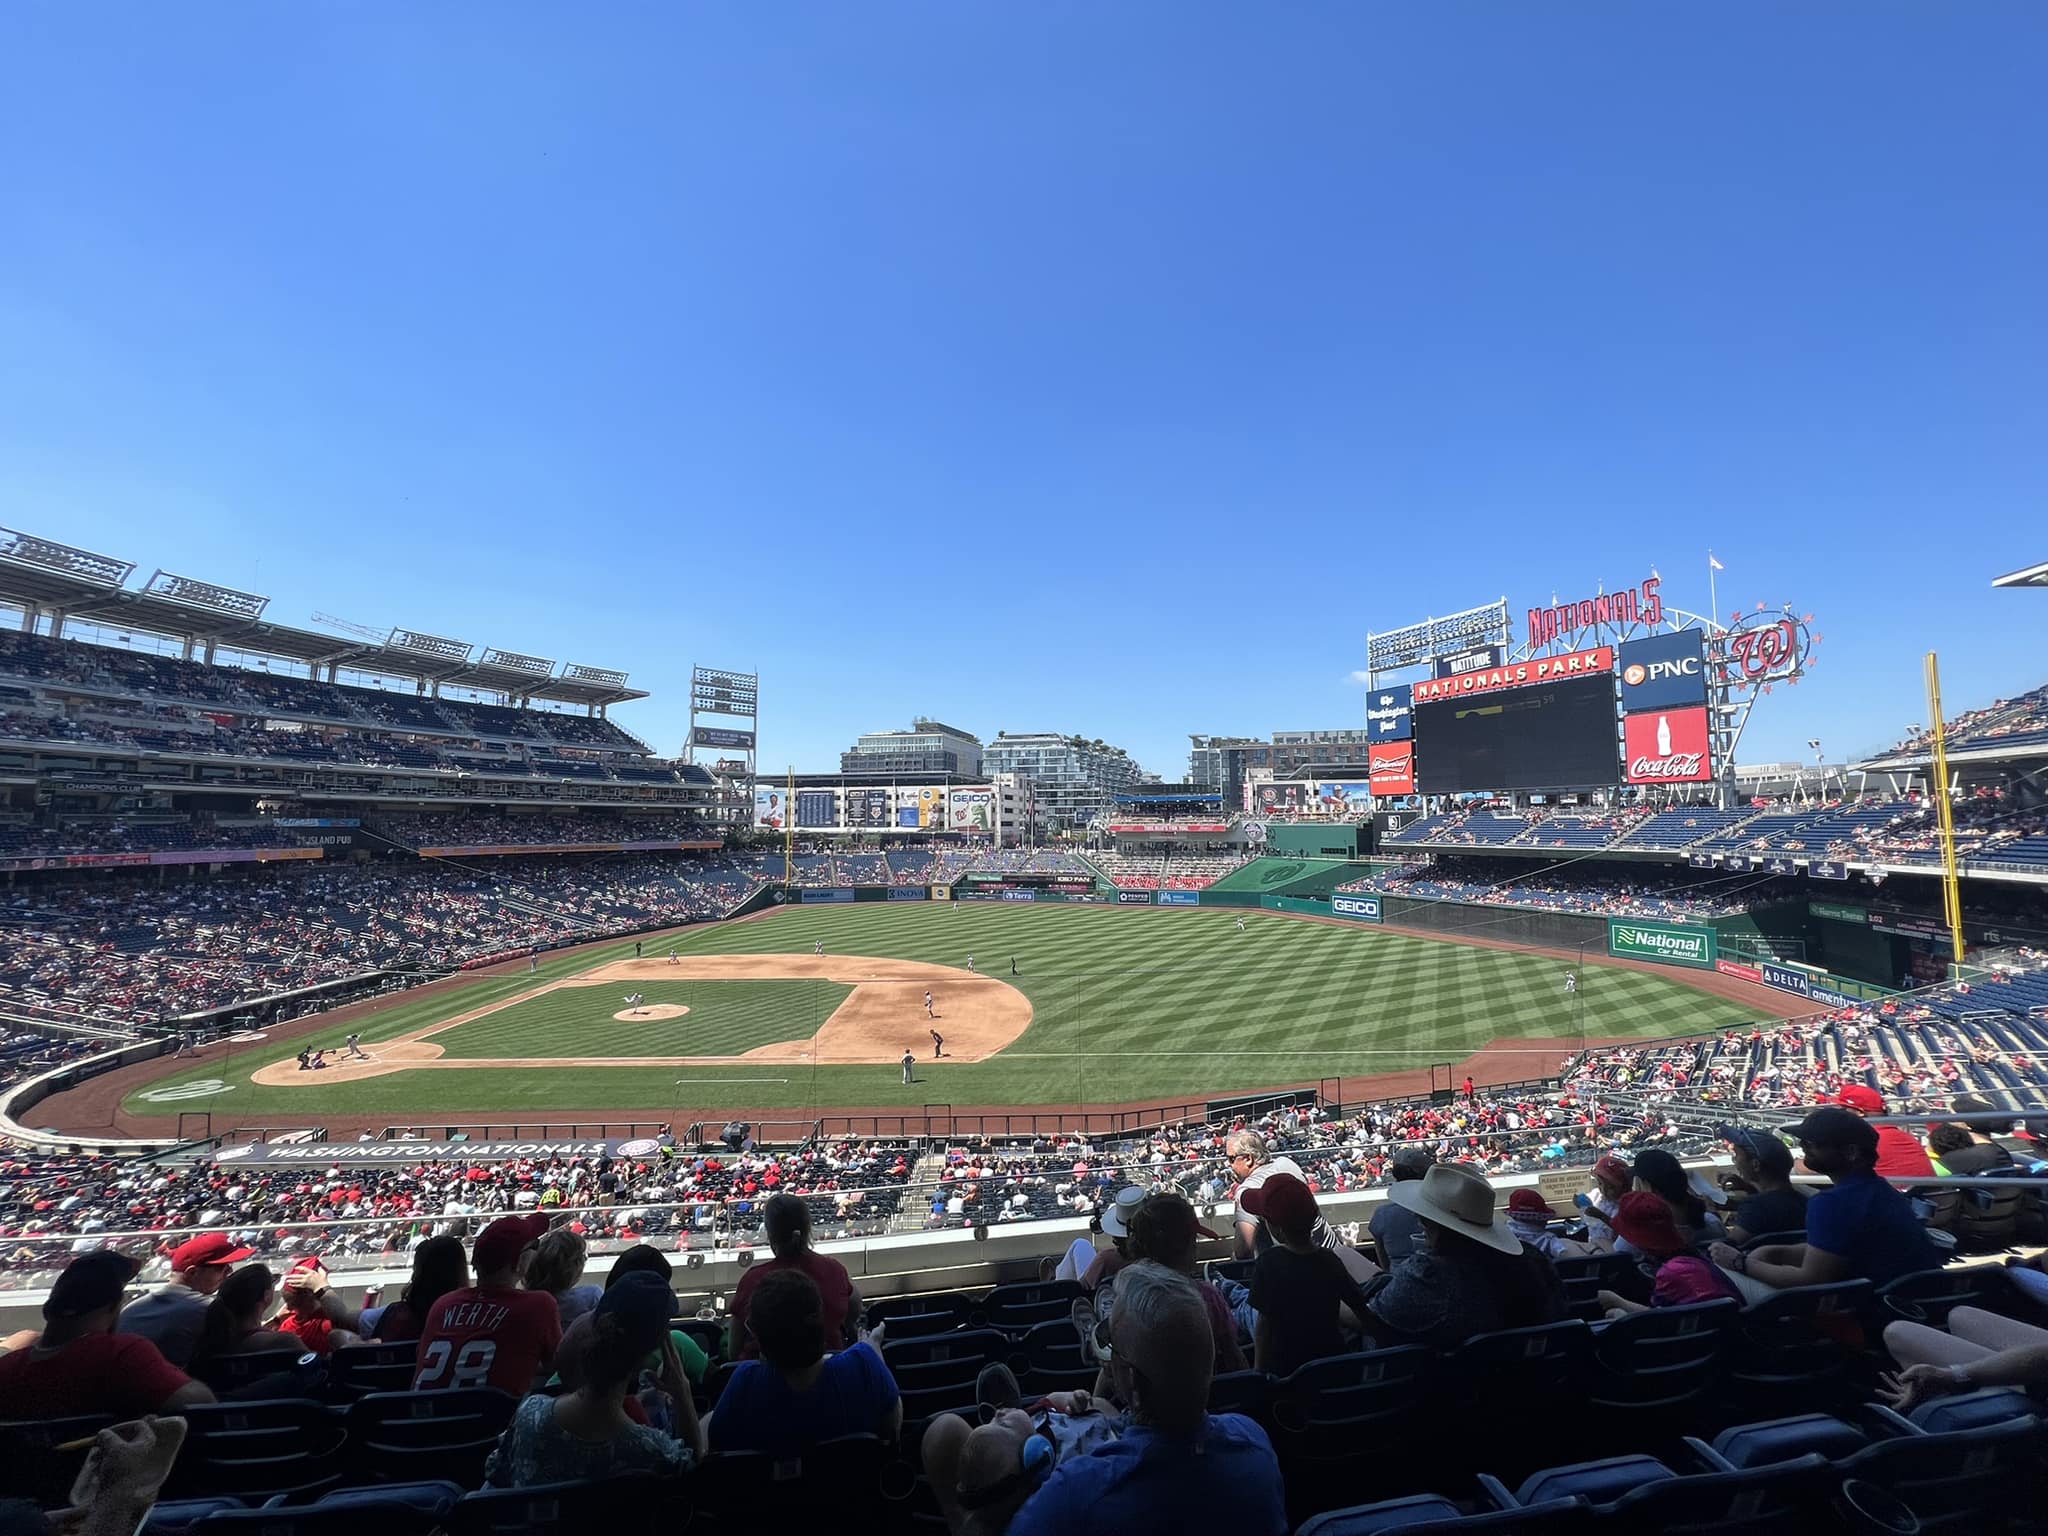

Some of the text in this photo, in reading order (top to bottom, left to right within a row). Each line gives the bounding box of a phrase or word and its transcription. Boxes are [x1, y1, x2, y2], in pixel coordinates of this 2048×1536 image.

[1528, 577, 1661, 649] NATIONALS
[1450, 651, 1491, 673] NATITUDE
[1648, 658, 1698, 680] PNC
[1419, 654, 1599, 698] NATIONALS PARK
[1630, 753, 1704, 777] Coca-Cola
[66, 783, 117, 792] CHAMPIONS
[953, 794, 990, 802] GEICO
[897, 888, 924, 898] INOVA
[1334, 899, 1377, 915] GEICO
[1635, 931, 1702, 951] National
[1658, 947, 1698, 958] Car Rental
[1773, 973, 1807, 990] DELTA
[267, 1145, 453, 1158] WASHINGTON
[452, 1143, 607, 1155] NATIONALS
[443, 1303, 510, 1331] WERTH
[415, 1340, 497, 1391] 28
